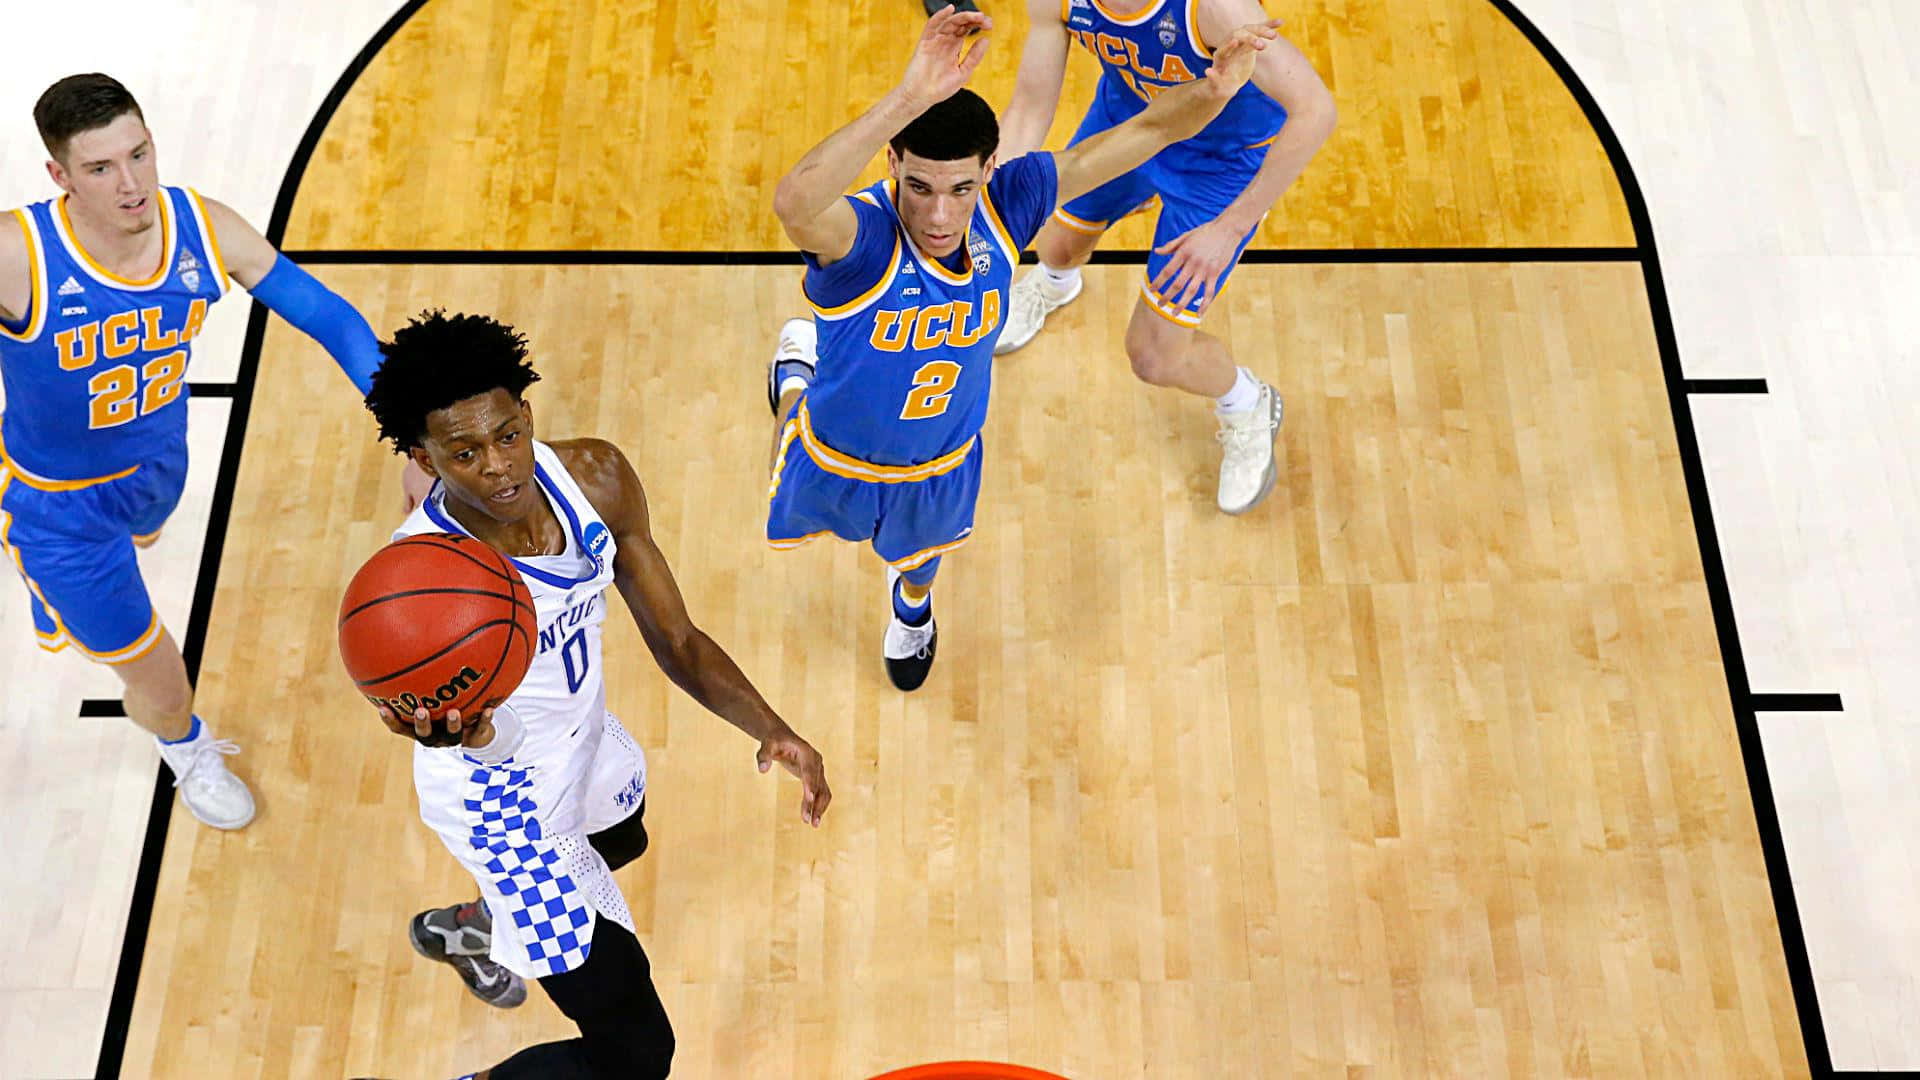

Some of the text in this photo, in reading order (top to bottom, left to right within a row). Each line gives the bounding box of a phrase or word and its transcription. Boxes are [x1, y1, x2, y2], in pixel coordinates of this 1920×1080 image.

[54, 298, 208, 372] UCLA
[869, 288, 1001, 353] UCLA
[88, 350, 189, 431] 22
[899, 359, 963, 420] 2
[589, 528, 608, 554] NCAA
[539, 592, 598, 655] NTUC
[561, 627, 590, 695] 0
